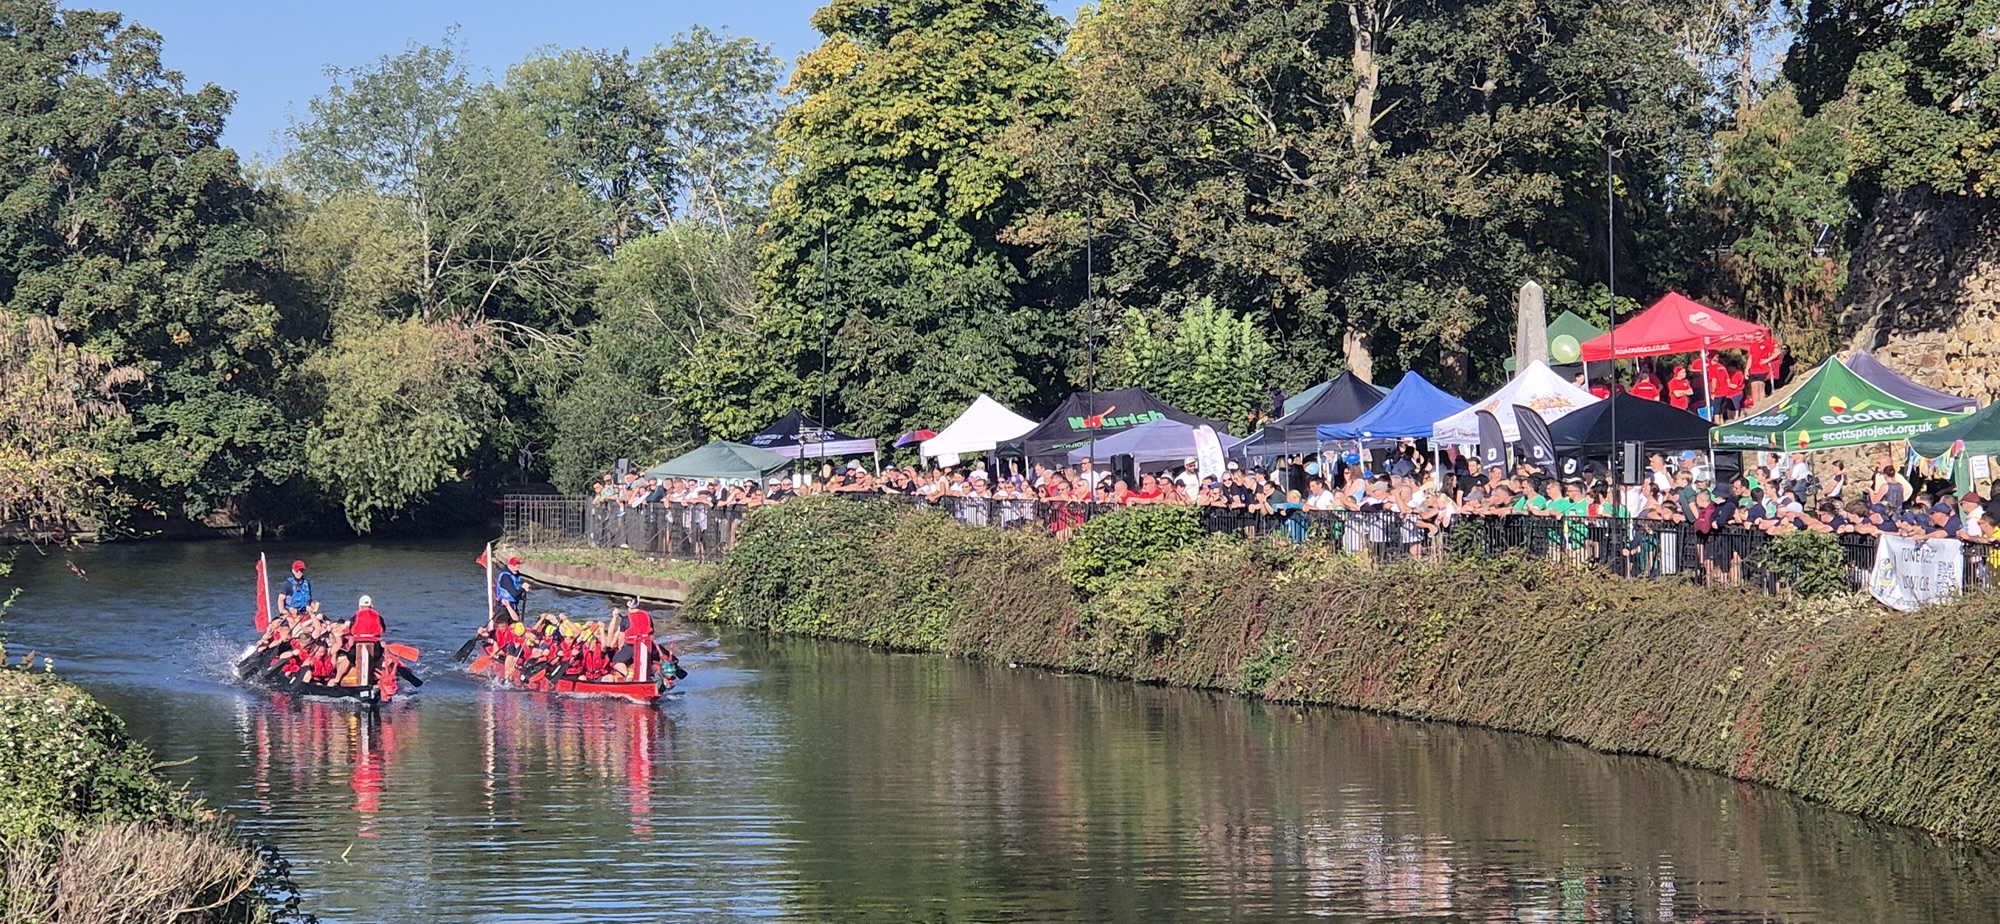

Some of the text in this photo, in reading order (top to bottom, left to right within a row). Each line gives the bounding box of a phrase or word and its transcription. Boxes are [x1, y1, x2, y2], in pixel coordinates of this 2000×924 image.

[1067, 410, 1167, 429] Nourish
[1820, 409, 1908, 425] scotts
[1822, 422, 1933, 441] scottsproject.org.uk
